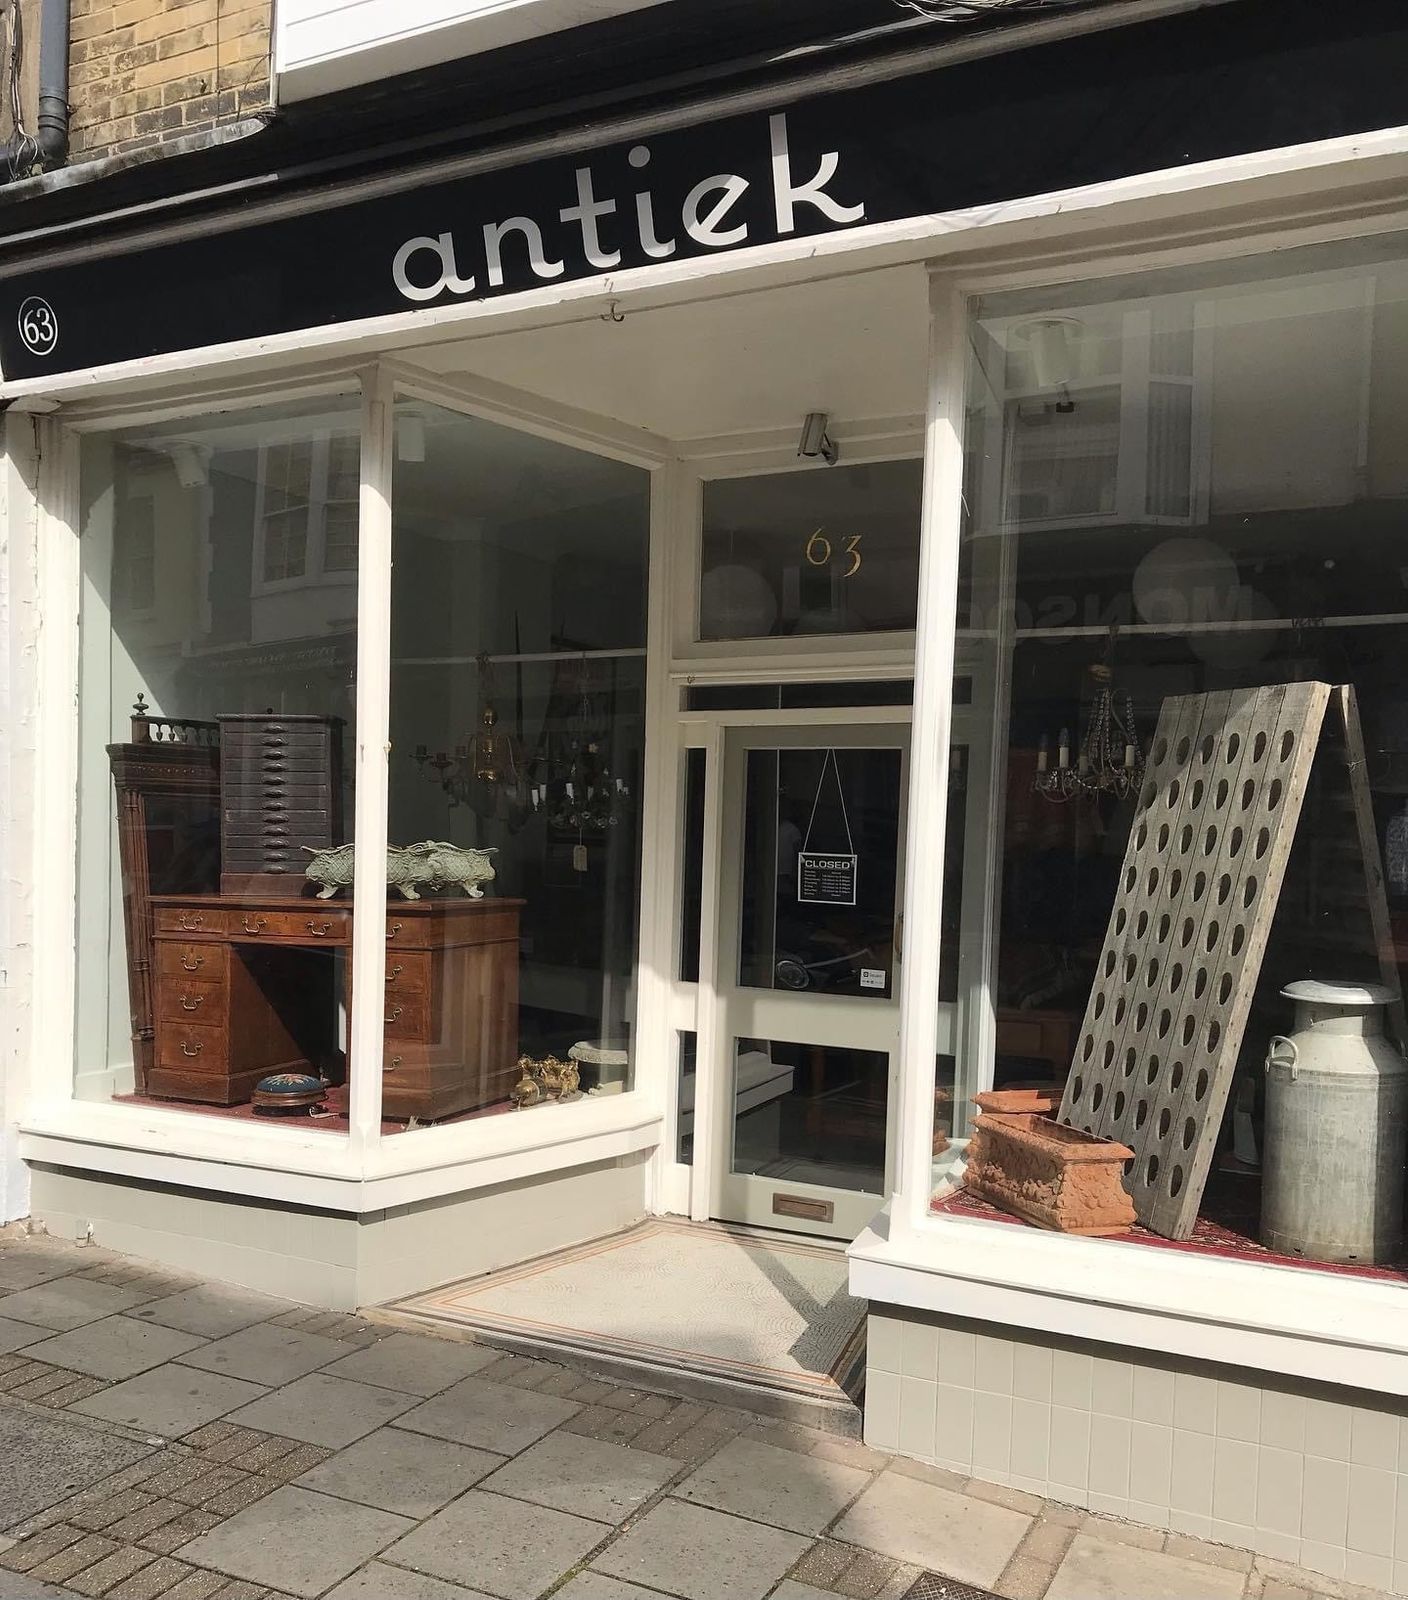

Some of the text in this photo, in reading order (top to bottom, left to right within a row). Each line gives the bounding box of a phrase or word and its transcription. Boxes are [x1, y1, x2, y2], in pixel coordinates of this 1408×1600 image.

[392, 113, 865, 301] antiek
[24, 308, 54, 344] 63
[806, 528, 863, 578] 63
[805, 860, 850, 869] CLOSED
